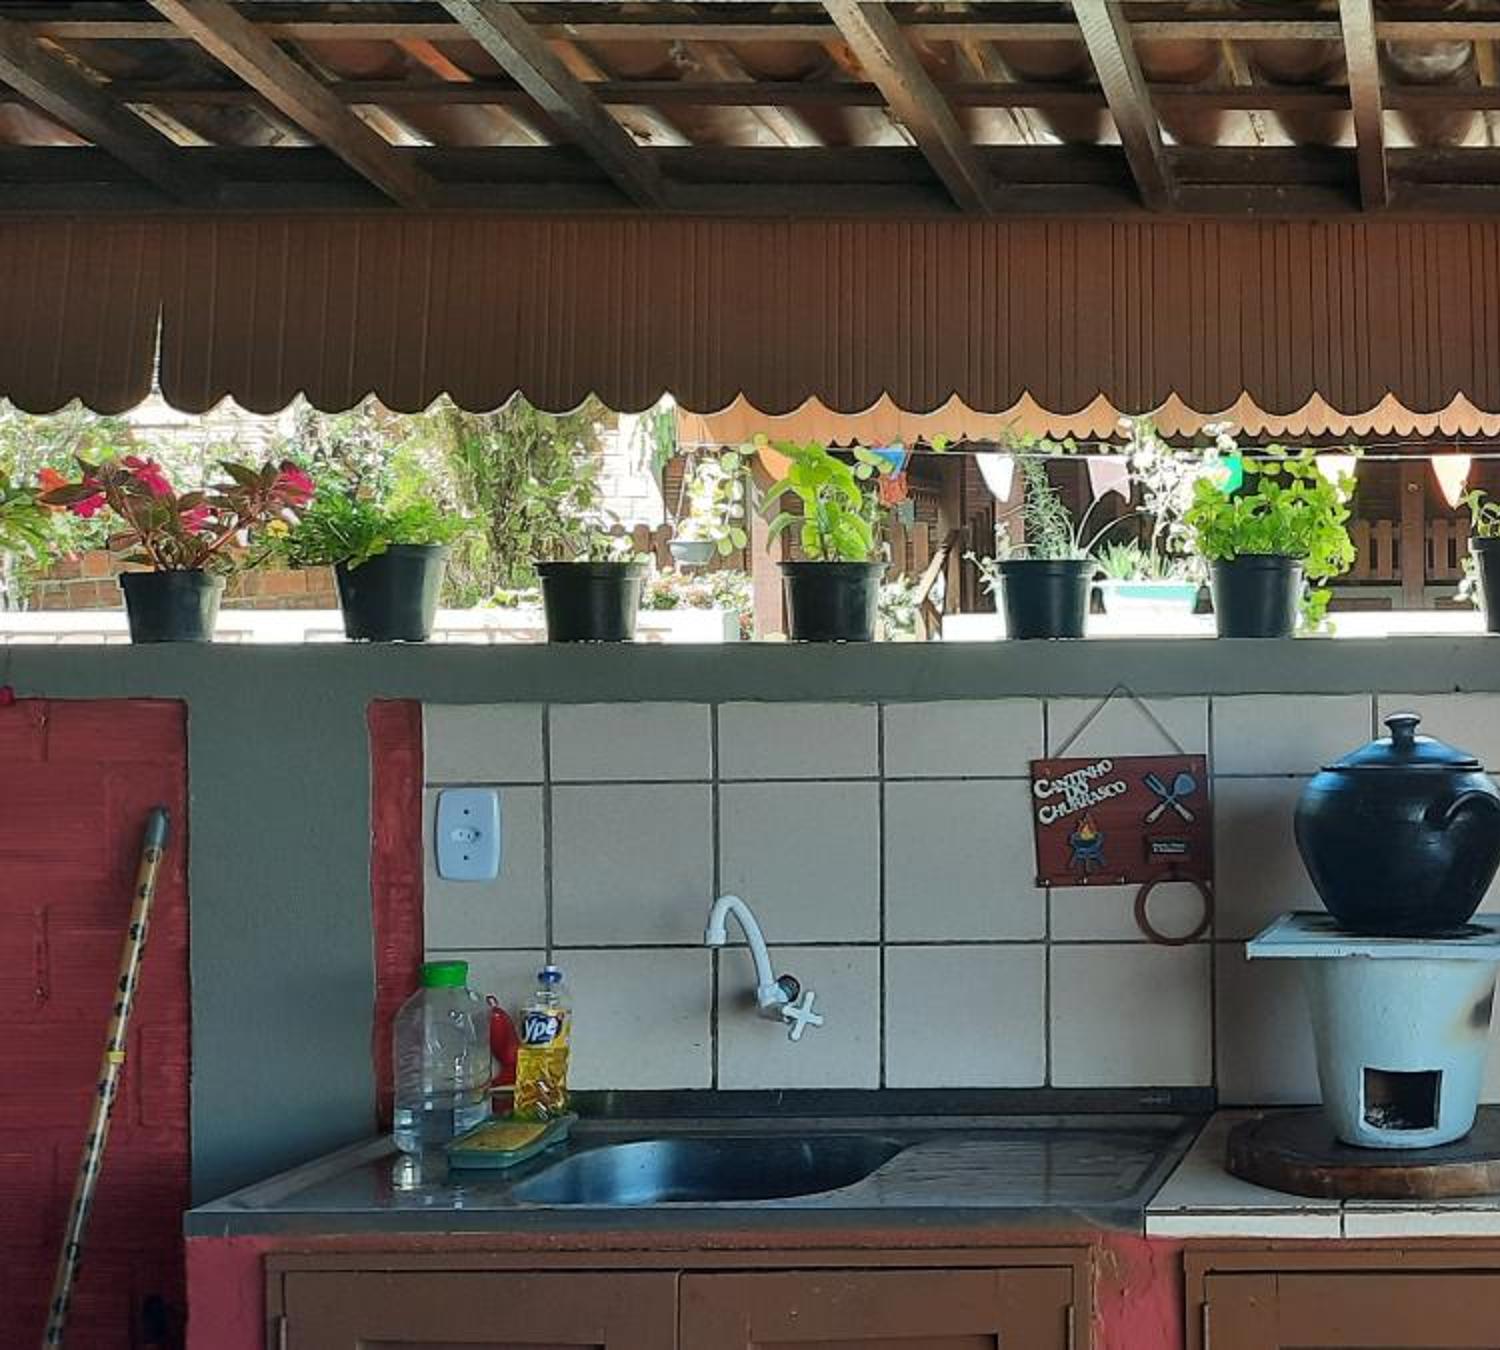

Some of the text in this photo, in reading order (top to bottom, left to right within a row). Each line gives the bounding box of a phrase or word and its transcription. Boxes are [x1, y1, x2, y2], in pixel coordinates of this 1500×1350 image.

[1034, 760, 1113, 799] CANTINHO
[1066, 783, 1089, 802] DO
[1039, 781, 1127, 824] CHURRASCO
